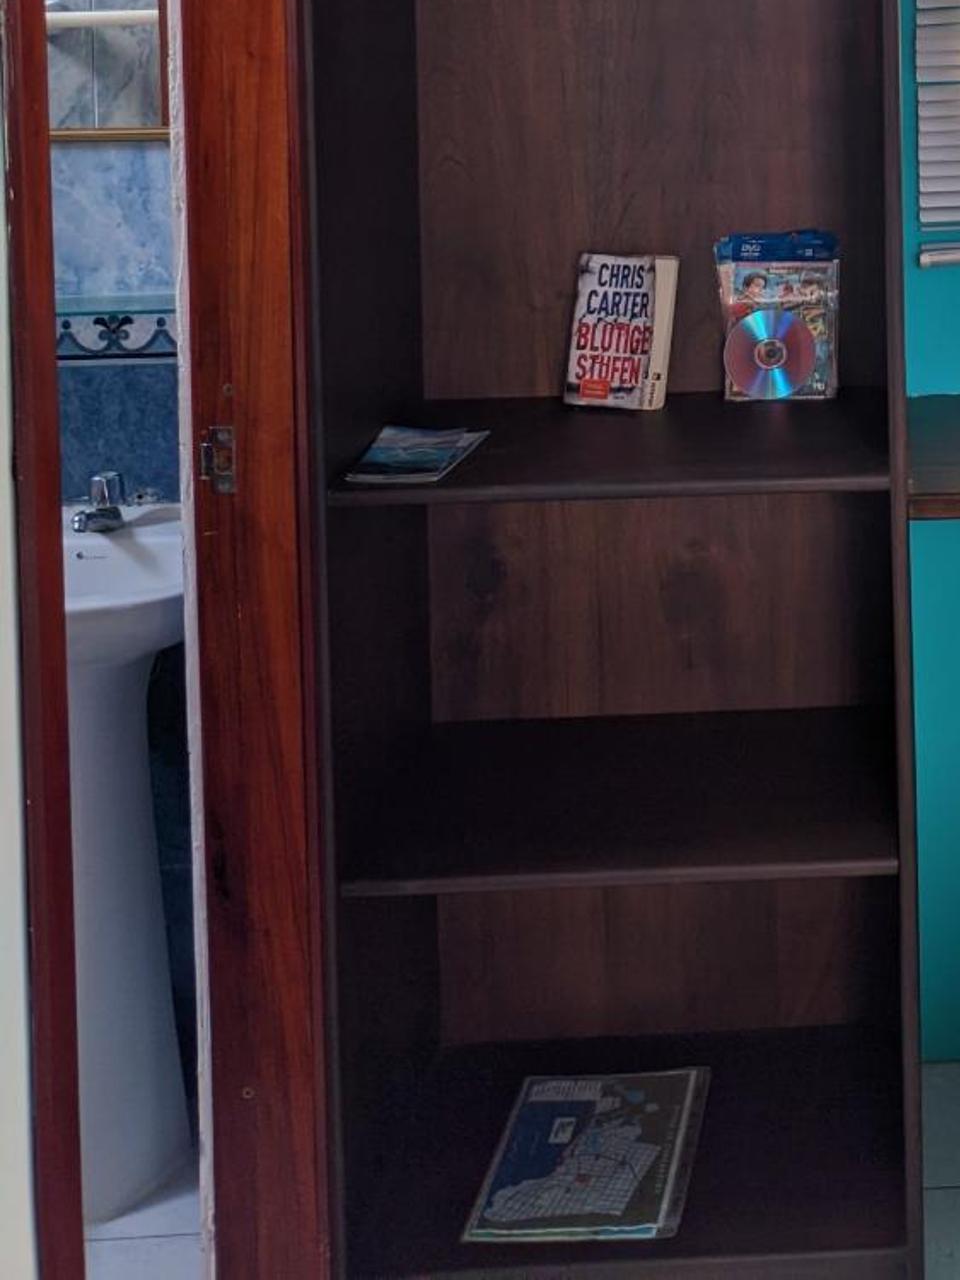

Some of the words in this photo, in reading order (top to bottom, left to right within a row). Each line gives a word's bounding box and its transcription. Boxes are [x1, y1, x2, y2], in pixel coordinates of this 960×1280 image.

[598, 263, 645, 289] CHRIS
[586, 289, 650, 319] CARTER
[576, 322, 654, 355] BLUTIGE
[575, 354, 642, 385] STUFEN
